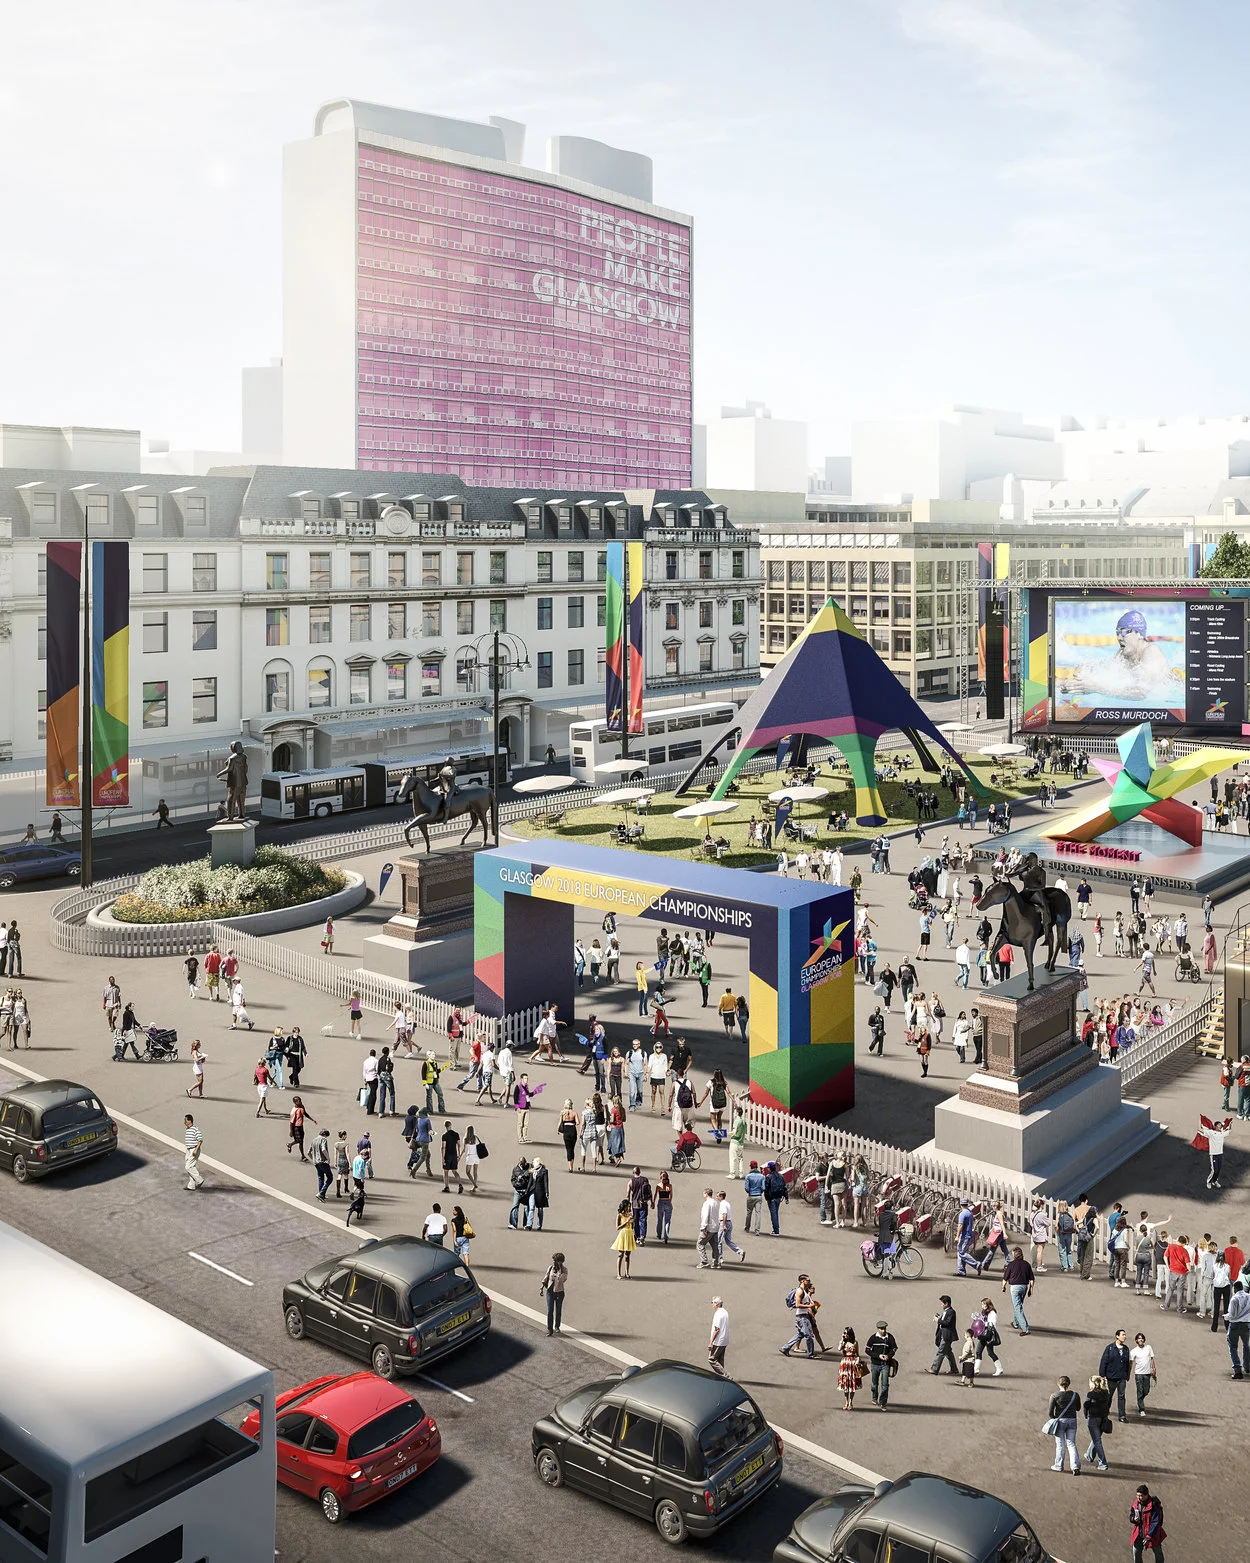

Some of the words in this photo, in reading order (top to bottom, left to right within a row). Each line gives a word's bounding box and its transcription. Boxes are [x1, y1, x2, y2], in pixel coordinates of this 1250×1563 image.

[580, 207, 681, 265] PEOPLE
[603, 250, 681, 296] MAKE
[532, 268, 680, 330] GLASGOW
[1095, 711, 1120, 719] ROSS
[1122, 711, 1168, 720] MURDOCH
[1089, 845, 1142, 862] MOMENT
[1049, 861, 1100, 876] EUROPEAN
[1105, 870, 1192, 890] CHAMPNSHIPS
[499, 867, 555, 889] GLASGOW
[556, 877, 581, 895] 2018
[584, 884, 646, 907] EUROPEAN
[649, 895, 752, 928] CHAMPIONSHIPS
[801, 953, 842, 979] EUROPEAN
